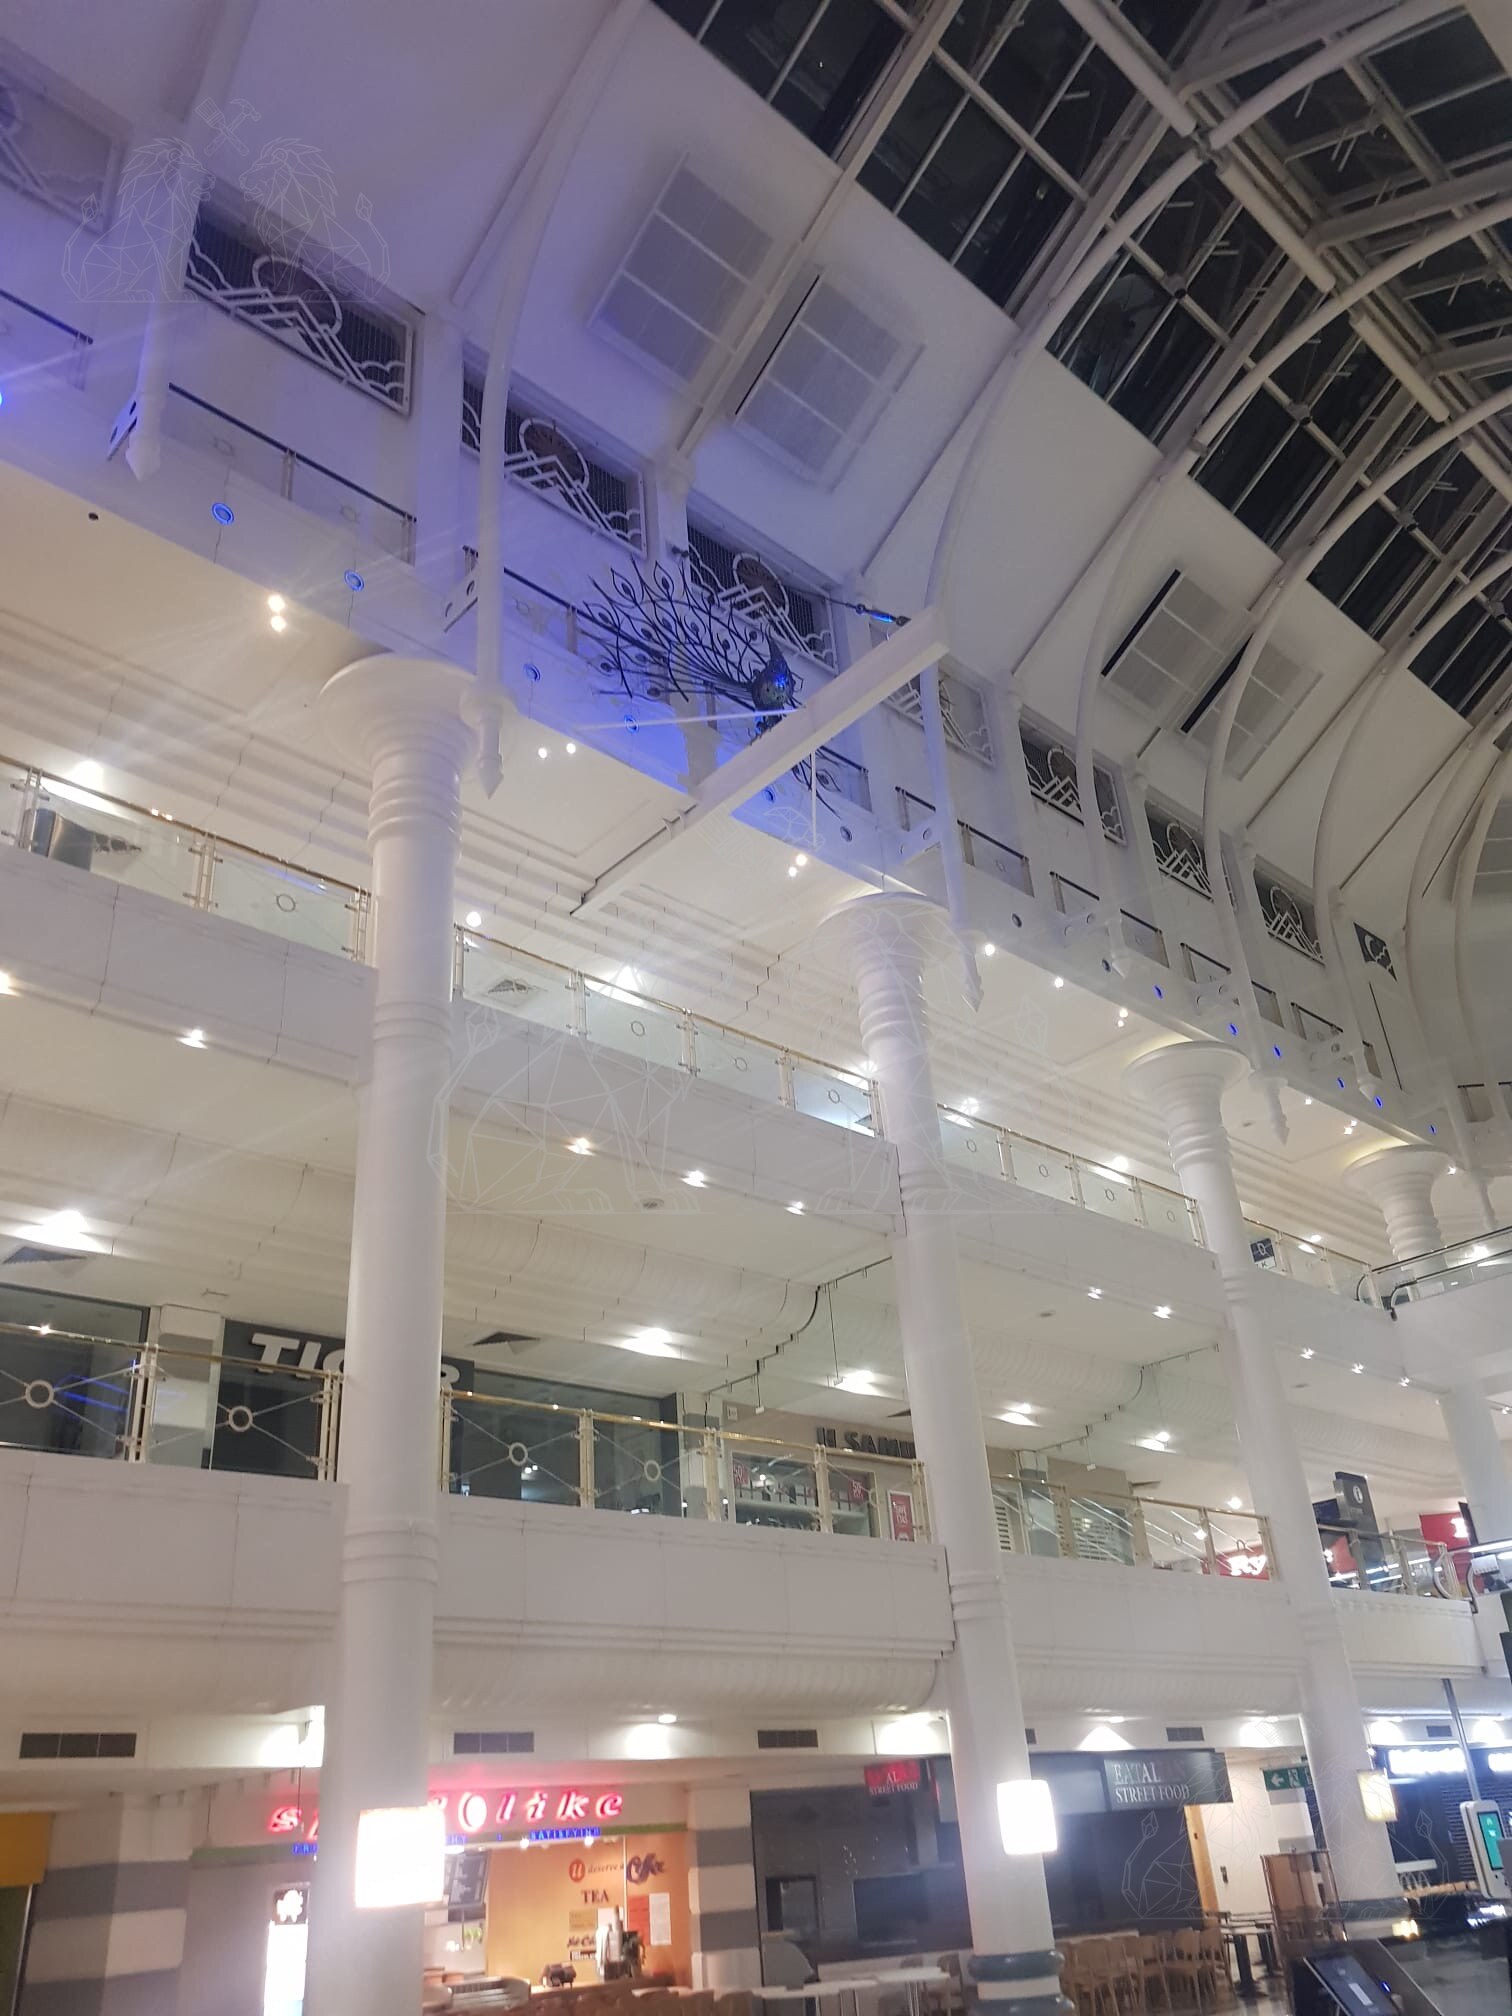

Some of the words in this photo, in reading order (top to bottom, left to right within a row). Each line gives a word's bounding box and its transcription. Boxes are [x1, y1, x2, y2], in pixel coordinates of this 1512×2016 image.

[1115, 1785, 1157, 1804] STREET
[1157, 1784, 1190, 1801] FOOD
[581, 1889, 609, 1904] TEA
